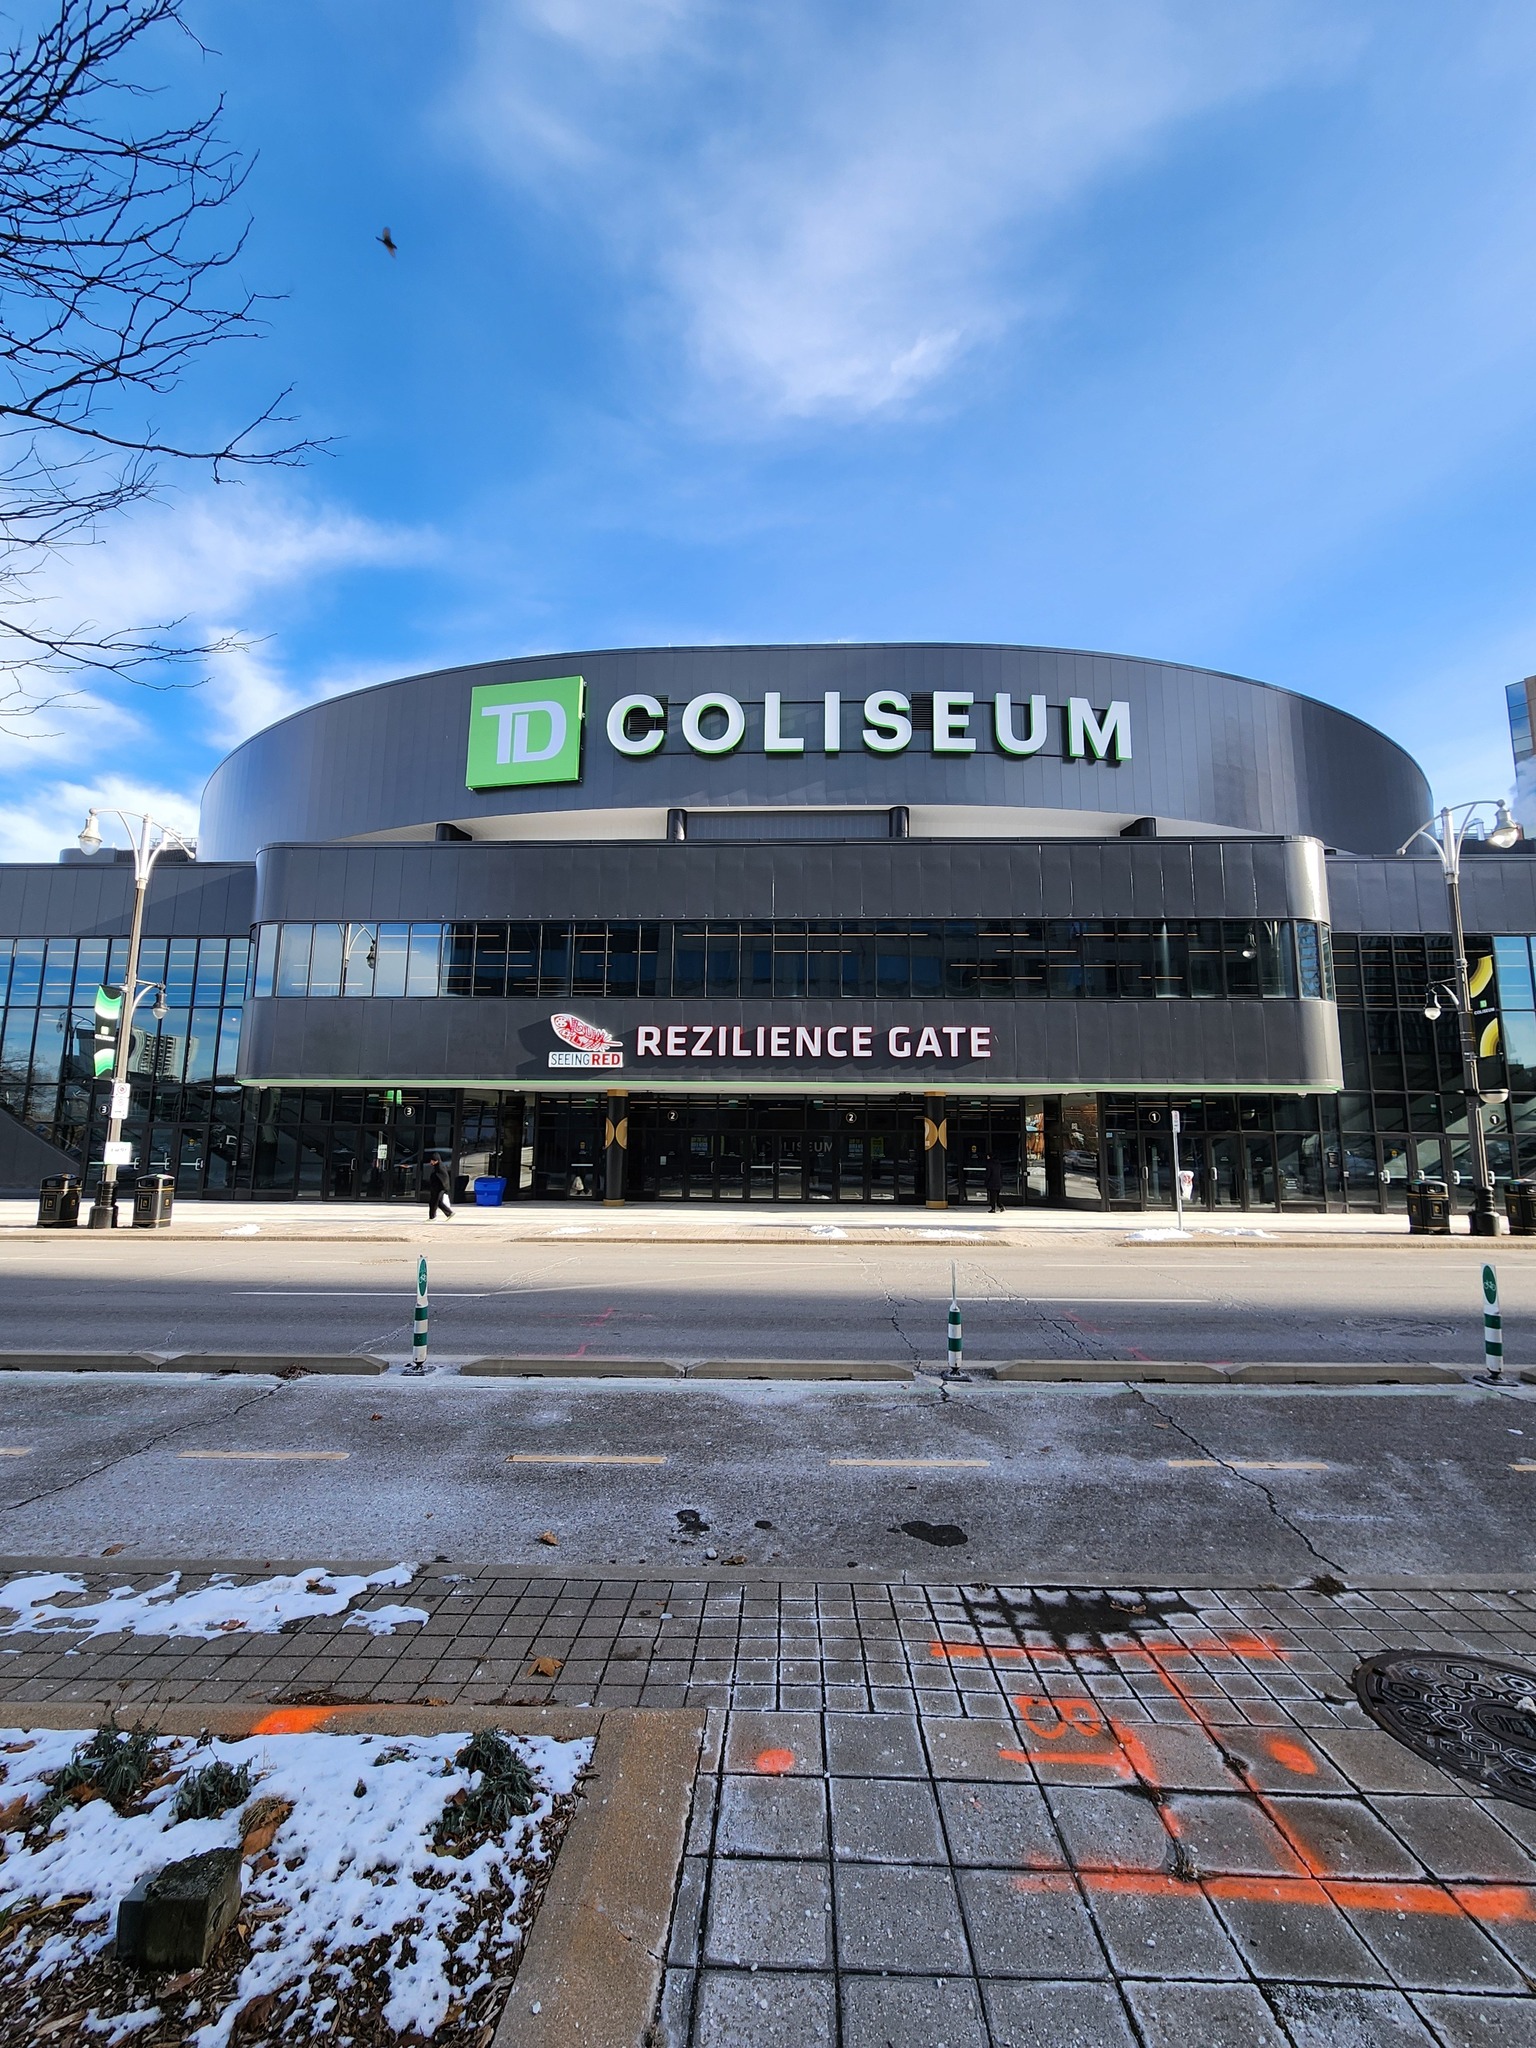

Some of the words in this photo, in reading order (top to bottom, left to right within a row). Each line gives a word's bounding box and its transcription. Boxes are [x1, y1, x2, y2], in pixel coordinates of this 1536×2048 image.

[481, 700, 565, 764] TD
[606, 690, 1133, 761] COLISEUM
[637, 1025, 873, 1058] REZILIENCE
[888, 1026, 992, 1059] GATE
